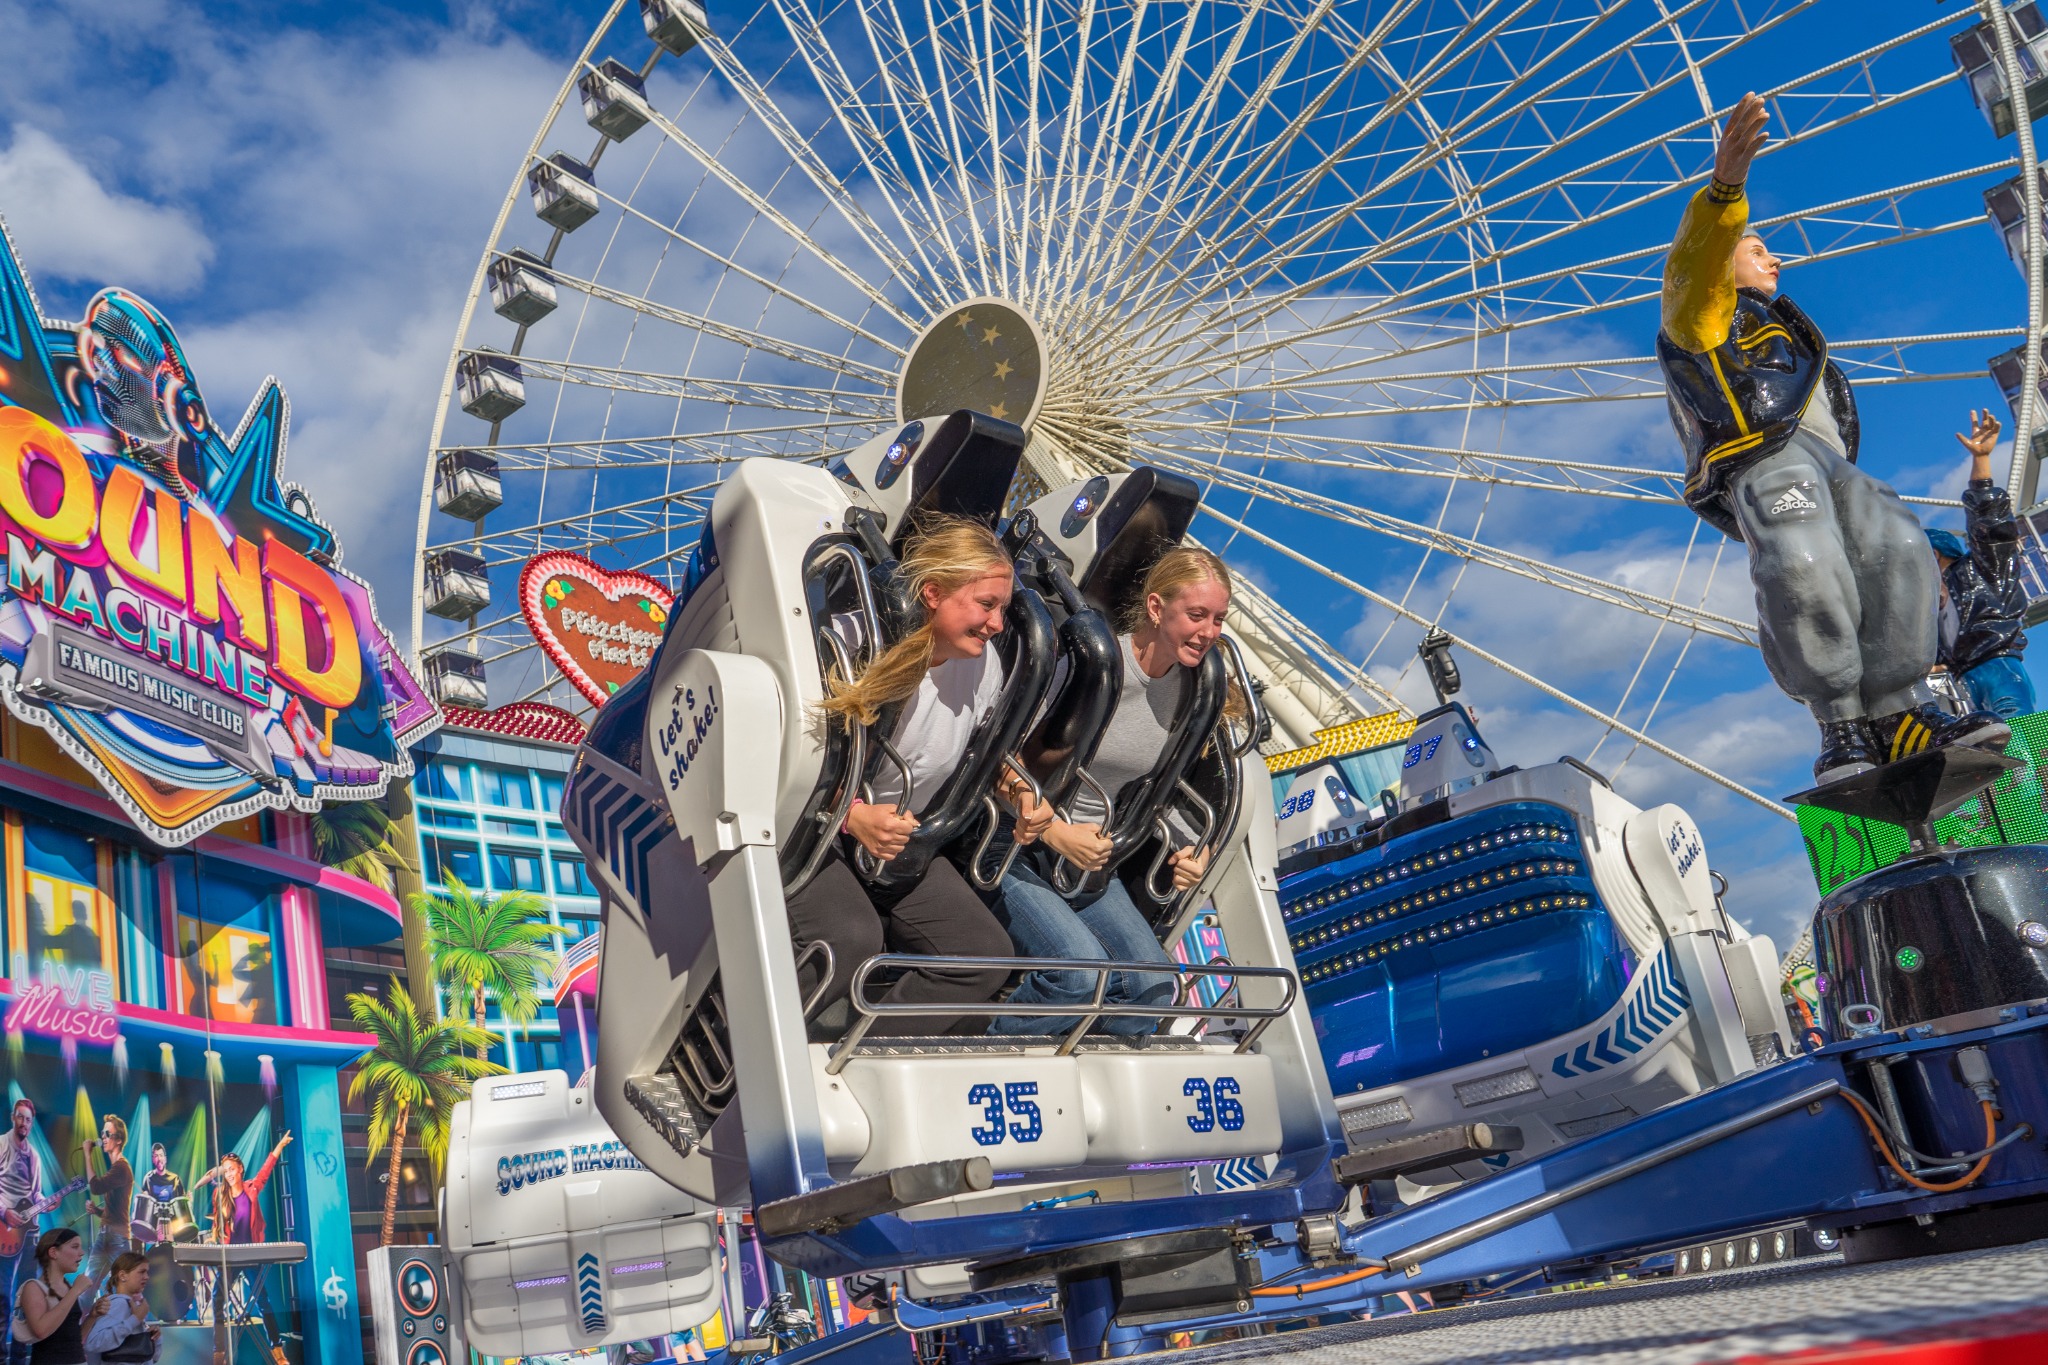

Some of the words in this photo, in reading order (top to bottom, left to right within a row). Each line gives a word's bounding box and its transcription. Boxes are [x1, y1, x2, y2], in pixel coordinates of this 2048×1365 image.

[1771, 500, 1817, 515] adidas
[7, 530, 270, 708] MACHINE
[59, 642, 140, 693] FAMOUS
[142, 672, 199, 717] MUSIC
[201, 699, 245, 737] CLUB
[669, 685, 718, 791] shake!
[1403, 734, 1443, 769] 37
[1279, 788, 1315, 820] 38
[1678, 833, 1702, 878] shake!
[14, 954, 114, 1012] LIVE
[6, 985, 119, 1040] Music
[968, 1081, 1042, 1146] 35
[1183, 1077, 1245, 1133] 36
[497, 1148, 569, 1196] SOUND
[571, 1139, 653, 1174] MACHI
